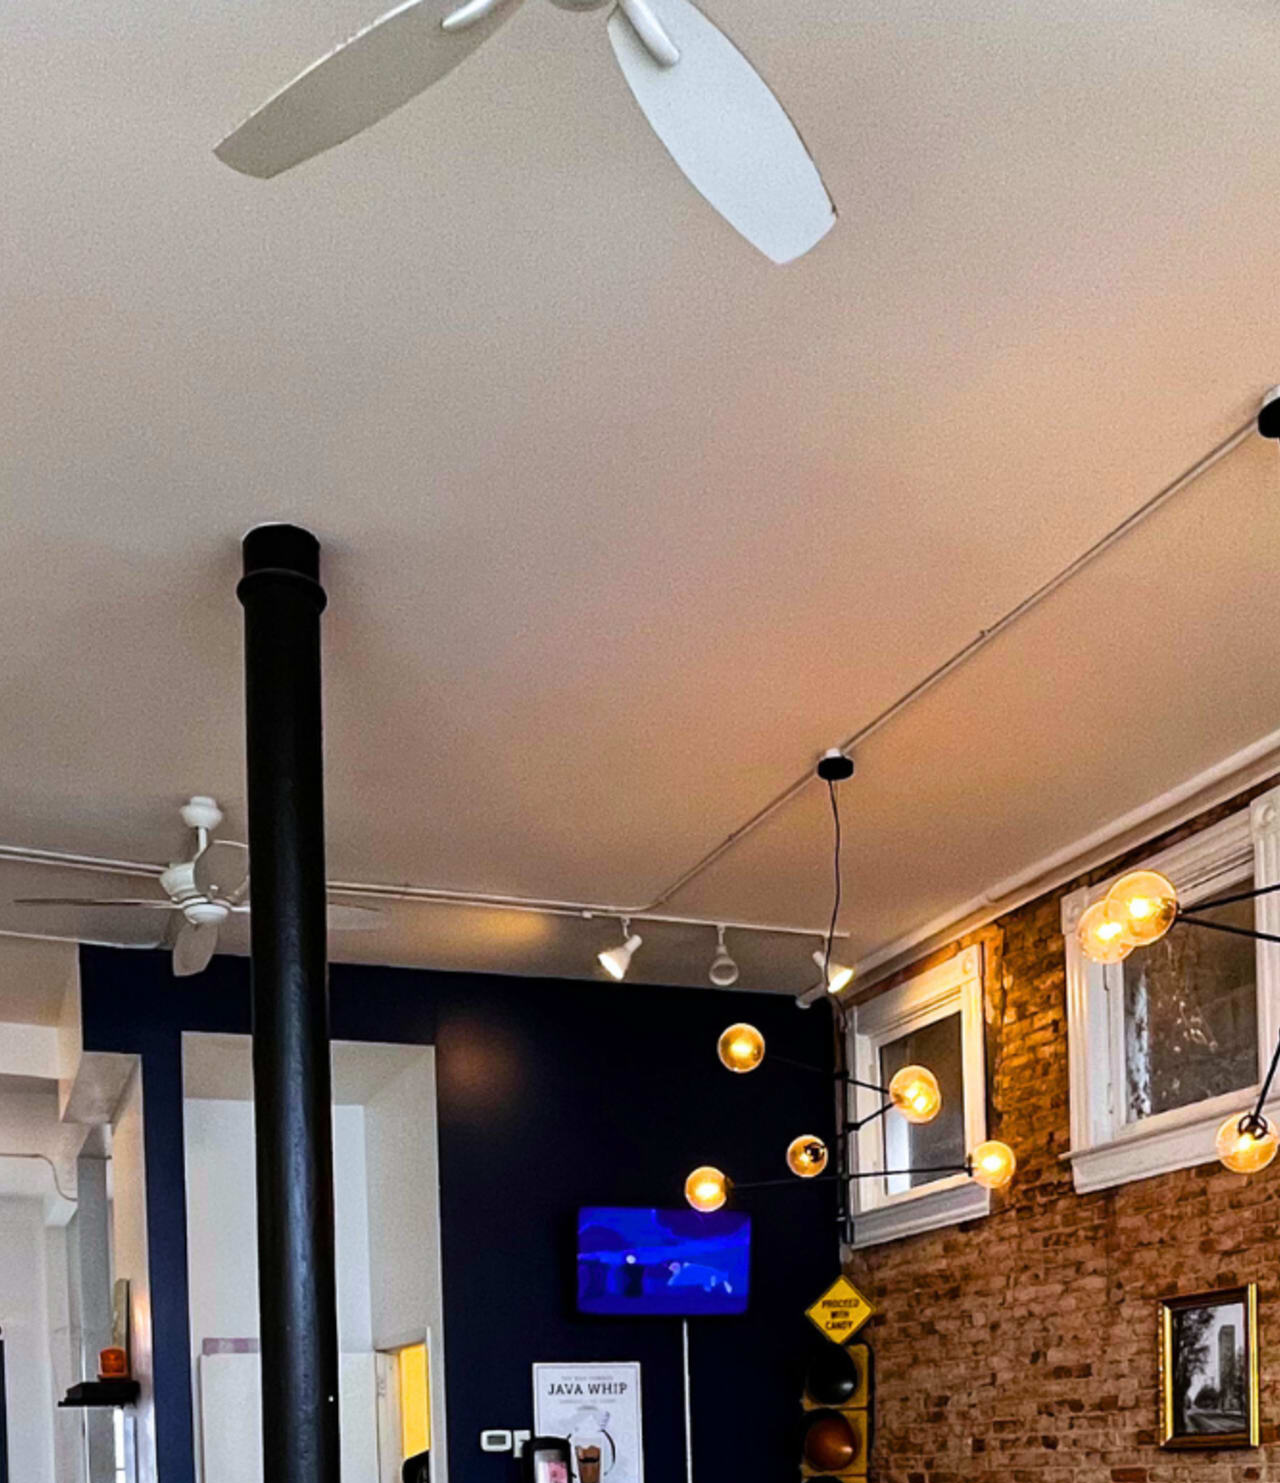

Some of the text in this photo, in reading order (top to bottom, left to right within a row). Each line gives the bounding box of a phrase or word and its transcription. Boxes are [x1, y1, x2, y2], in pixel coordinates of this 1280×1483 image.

[822, 1299, 860, 1308] PROCEED
[831, 1311, 849, 1319] WITH
[825, 1321, 853, 1329] CANDY
[548, 1381, 628, 1395] JAVA WHIP
